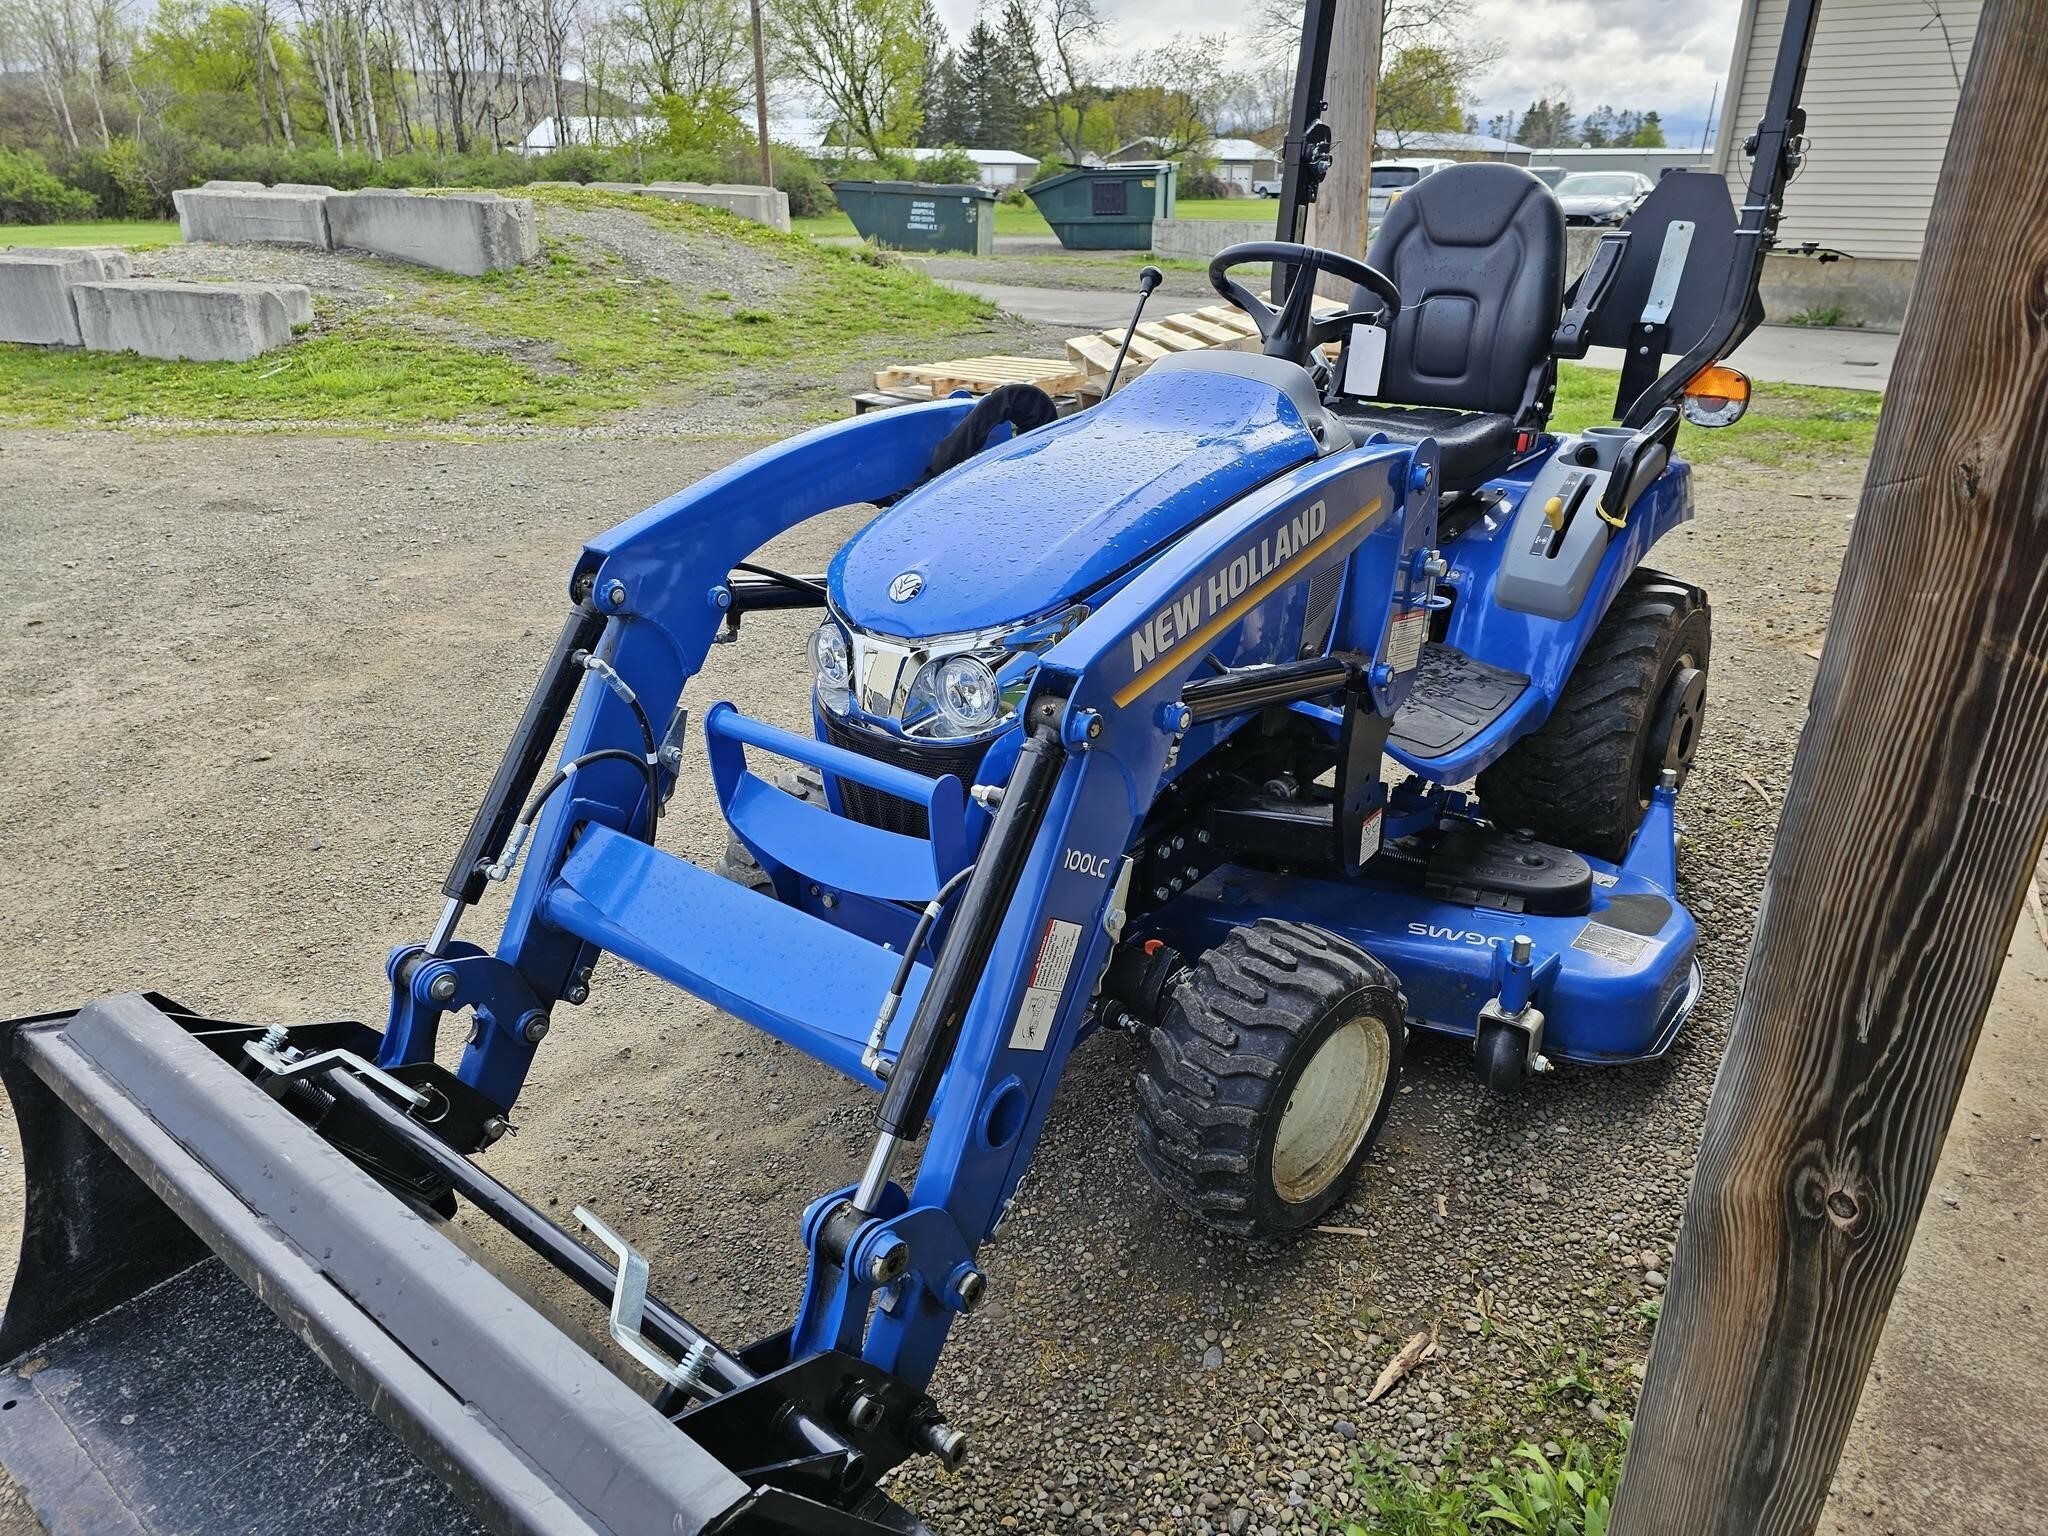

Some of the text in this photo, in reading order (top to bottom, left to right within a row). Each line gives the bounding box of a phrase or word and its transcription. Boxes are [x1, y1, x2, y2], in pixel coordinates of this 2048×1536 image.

[1130, 499, 1328, 673] NEW HOLLAND
[1063, 847, 1110, 879] 100LC
